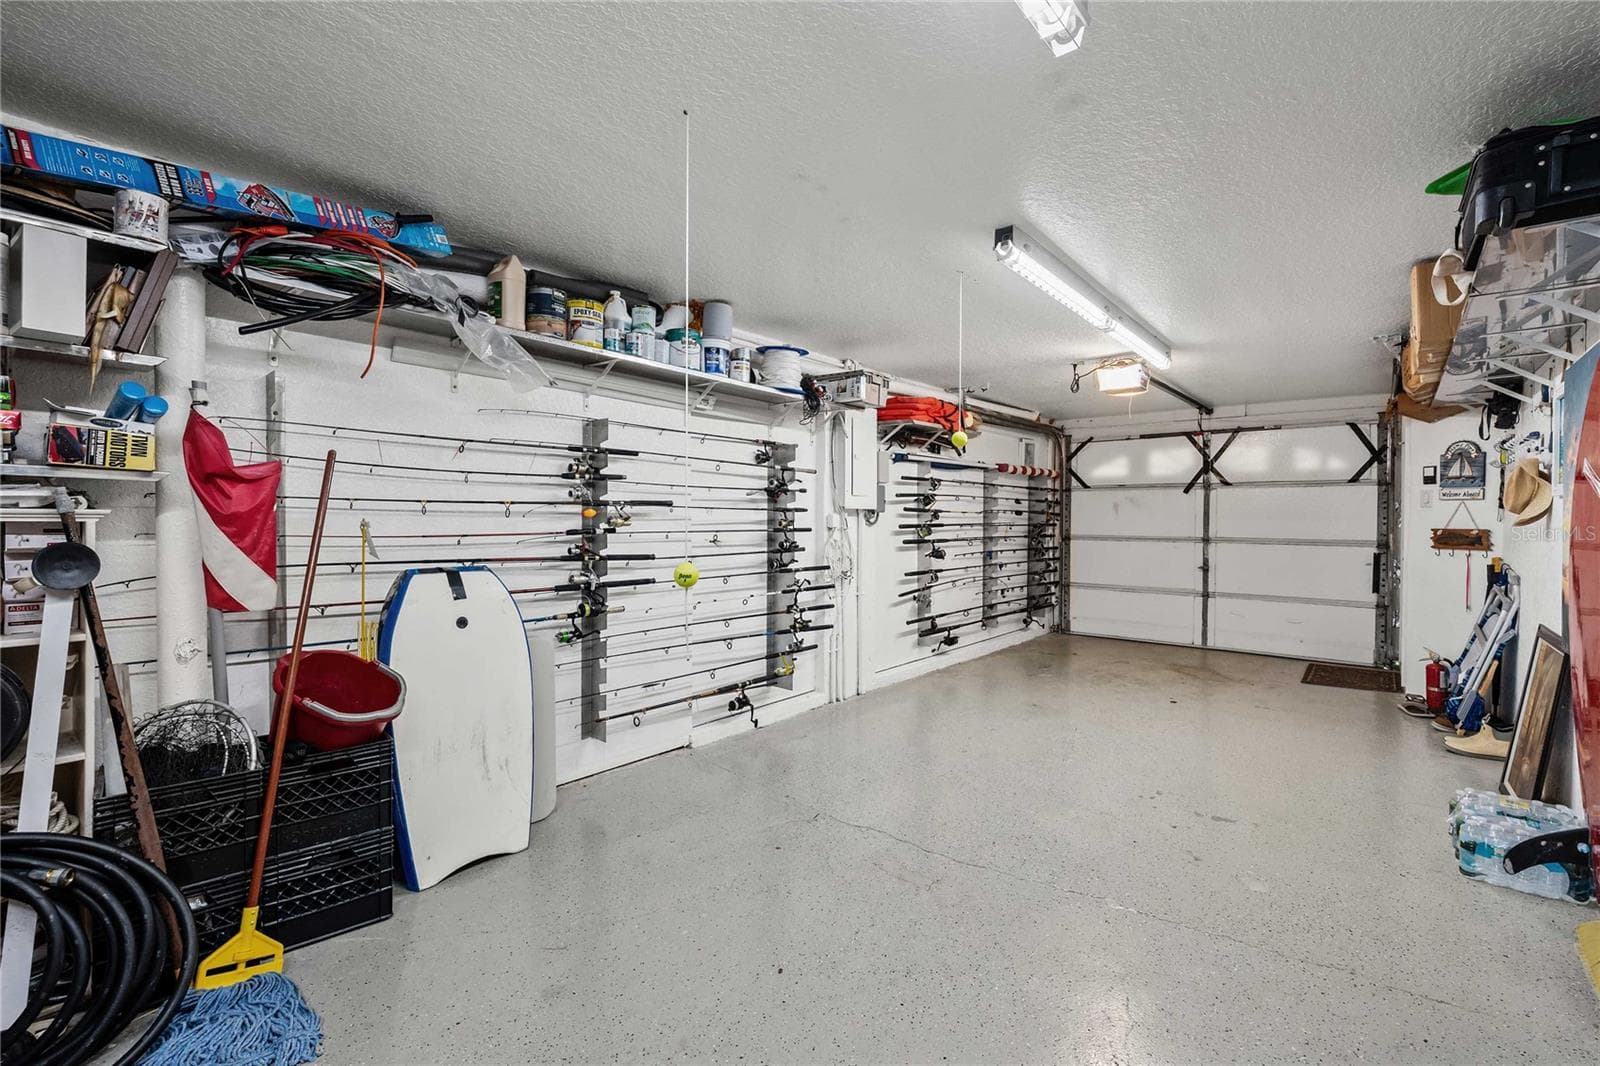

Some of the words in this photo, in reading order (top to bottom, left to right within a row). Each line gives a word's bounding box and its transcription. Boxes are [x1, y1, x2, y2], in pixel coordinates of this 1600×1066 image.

[97, 431, 106, 444] AUTO
[131, 435, 148, 458] TWIN
[109, 432, 128, 468] MOTORS
